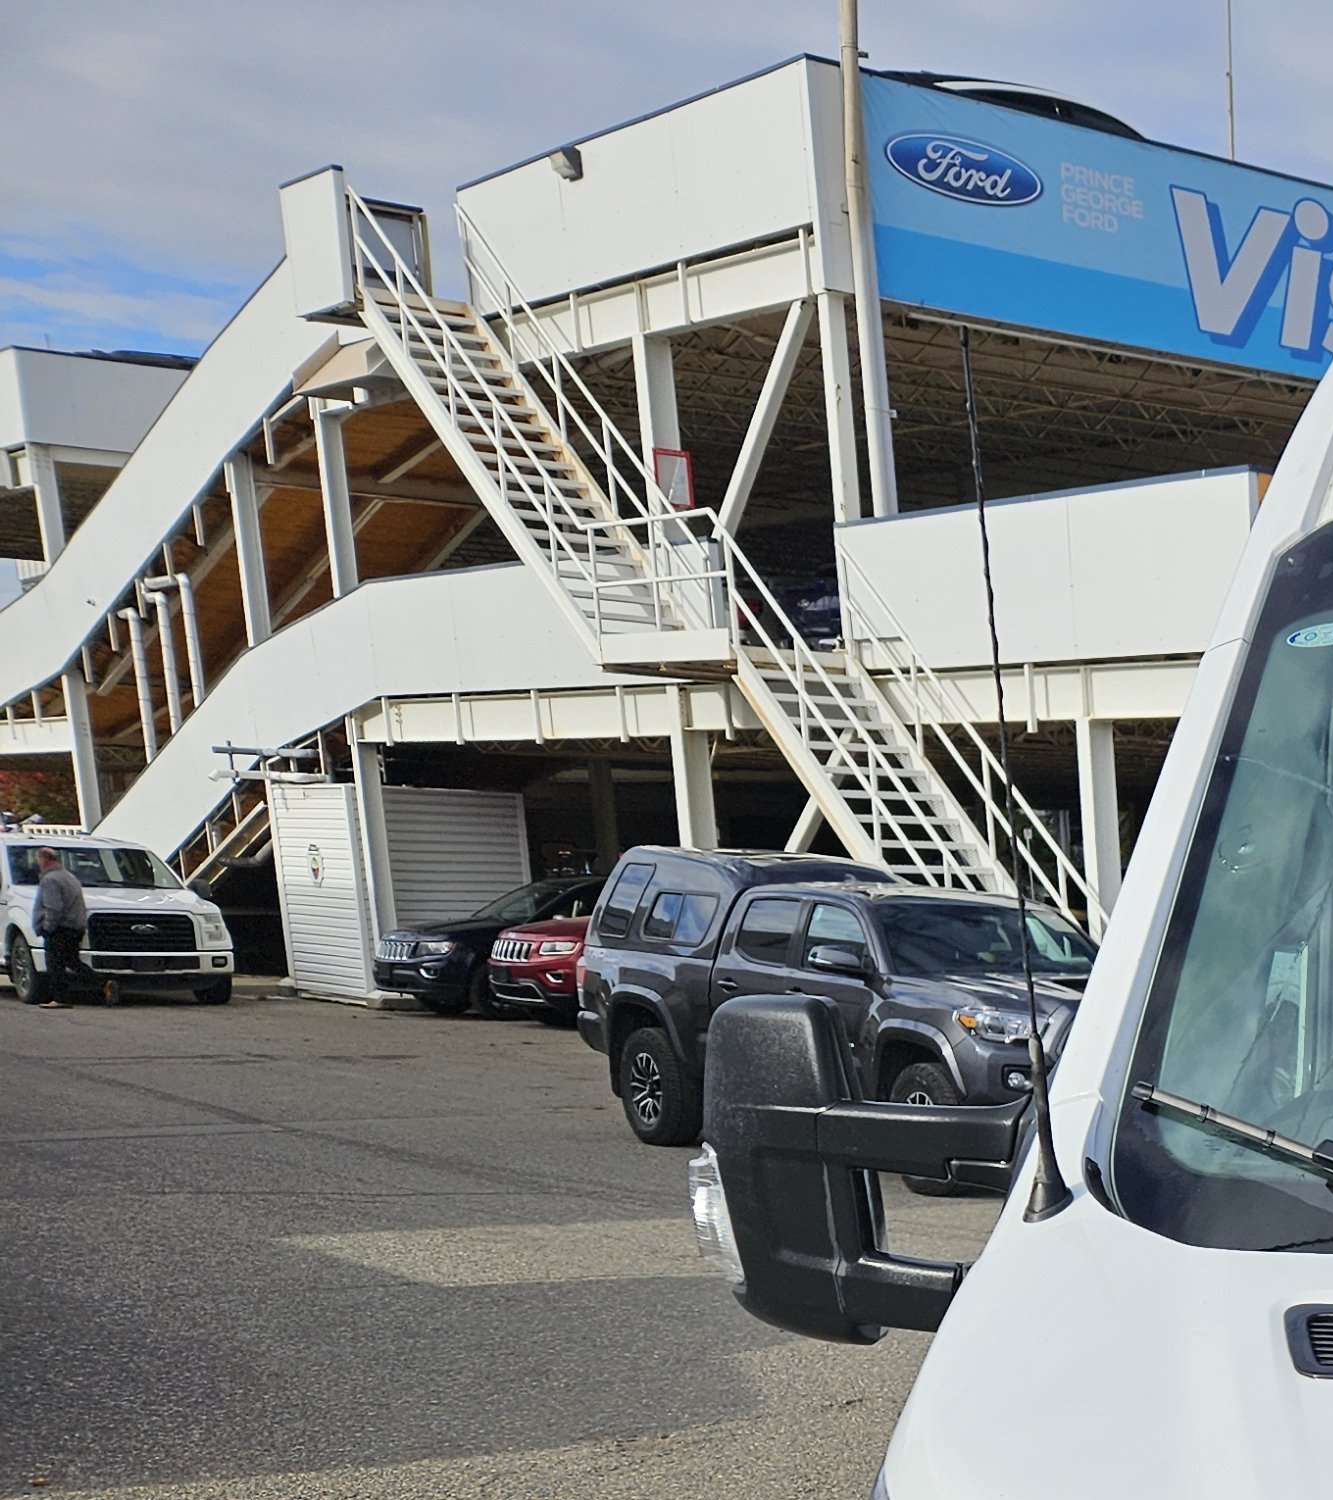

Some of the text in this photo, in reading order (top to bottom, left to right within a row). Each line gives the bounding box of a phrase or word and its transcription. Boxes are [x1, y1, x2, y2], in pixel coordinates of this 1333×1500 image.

[917, 140, 1012, 199] Ford
[1060, 161, 1134, 198] PRINCE
[1061, 184, 1144, 219] GEORGE
[1062, 204, 1120, 233] FORD
